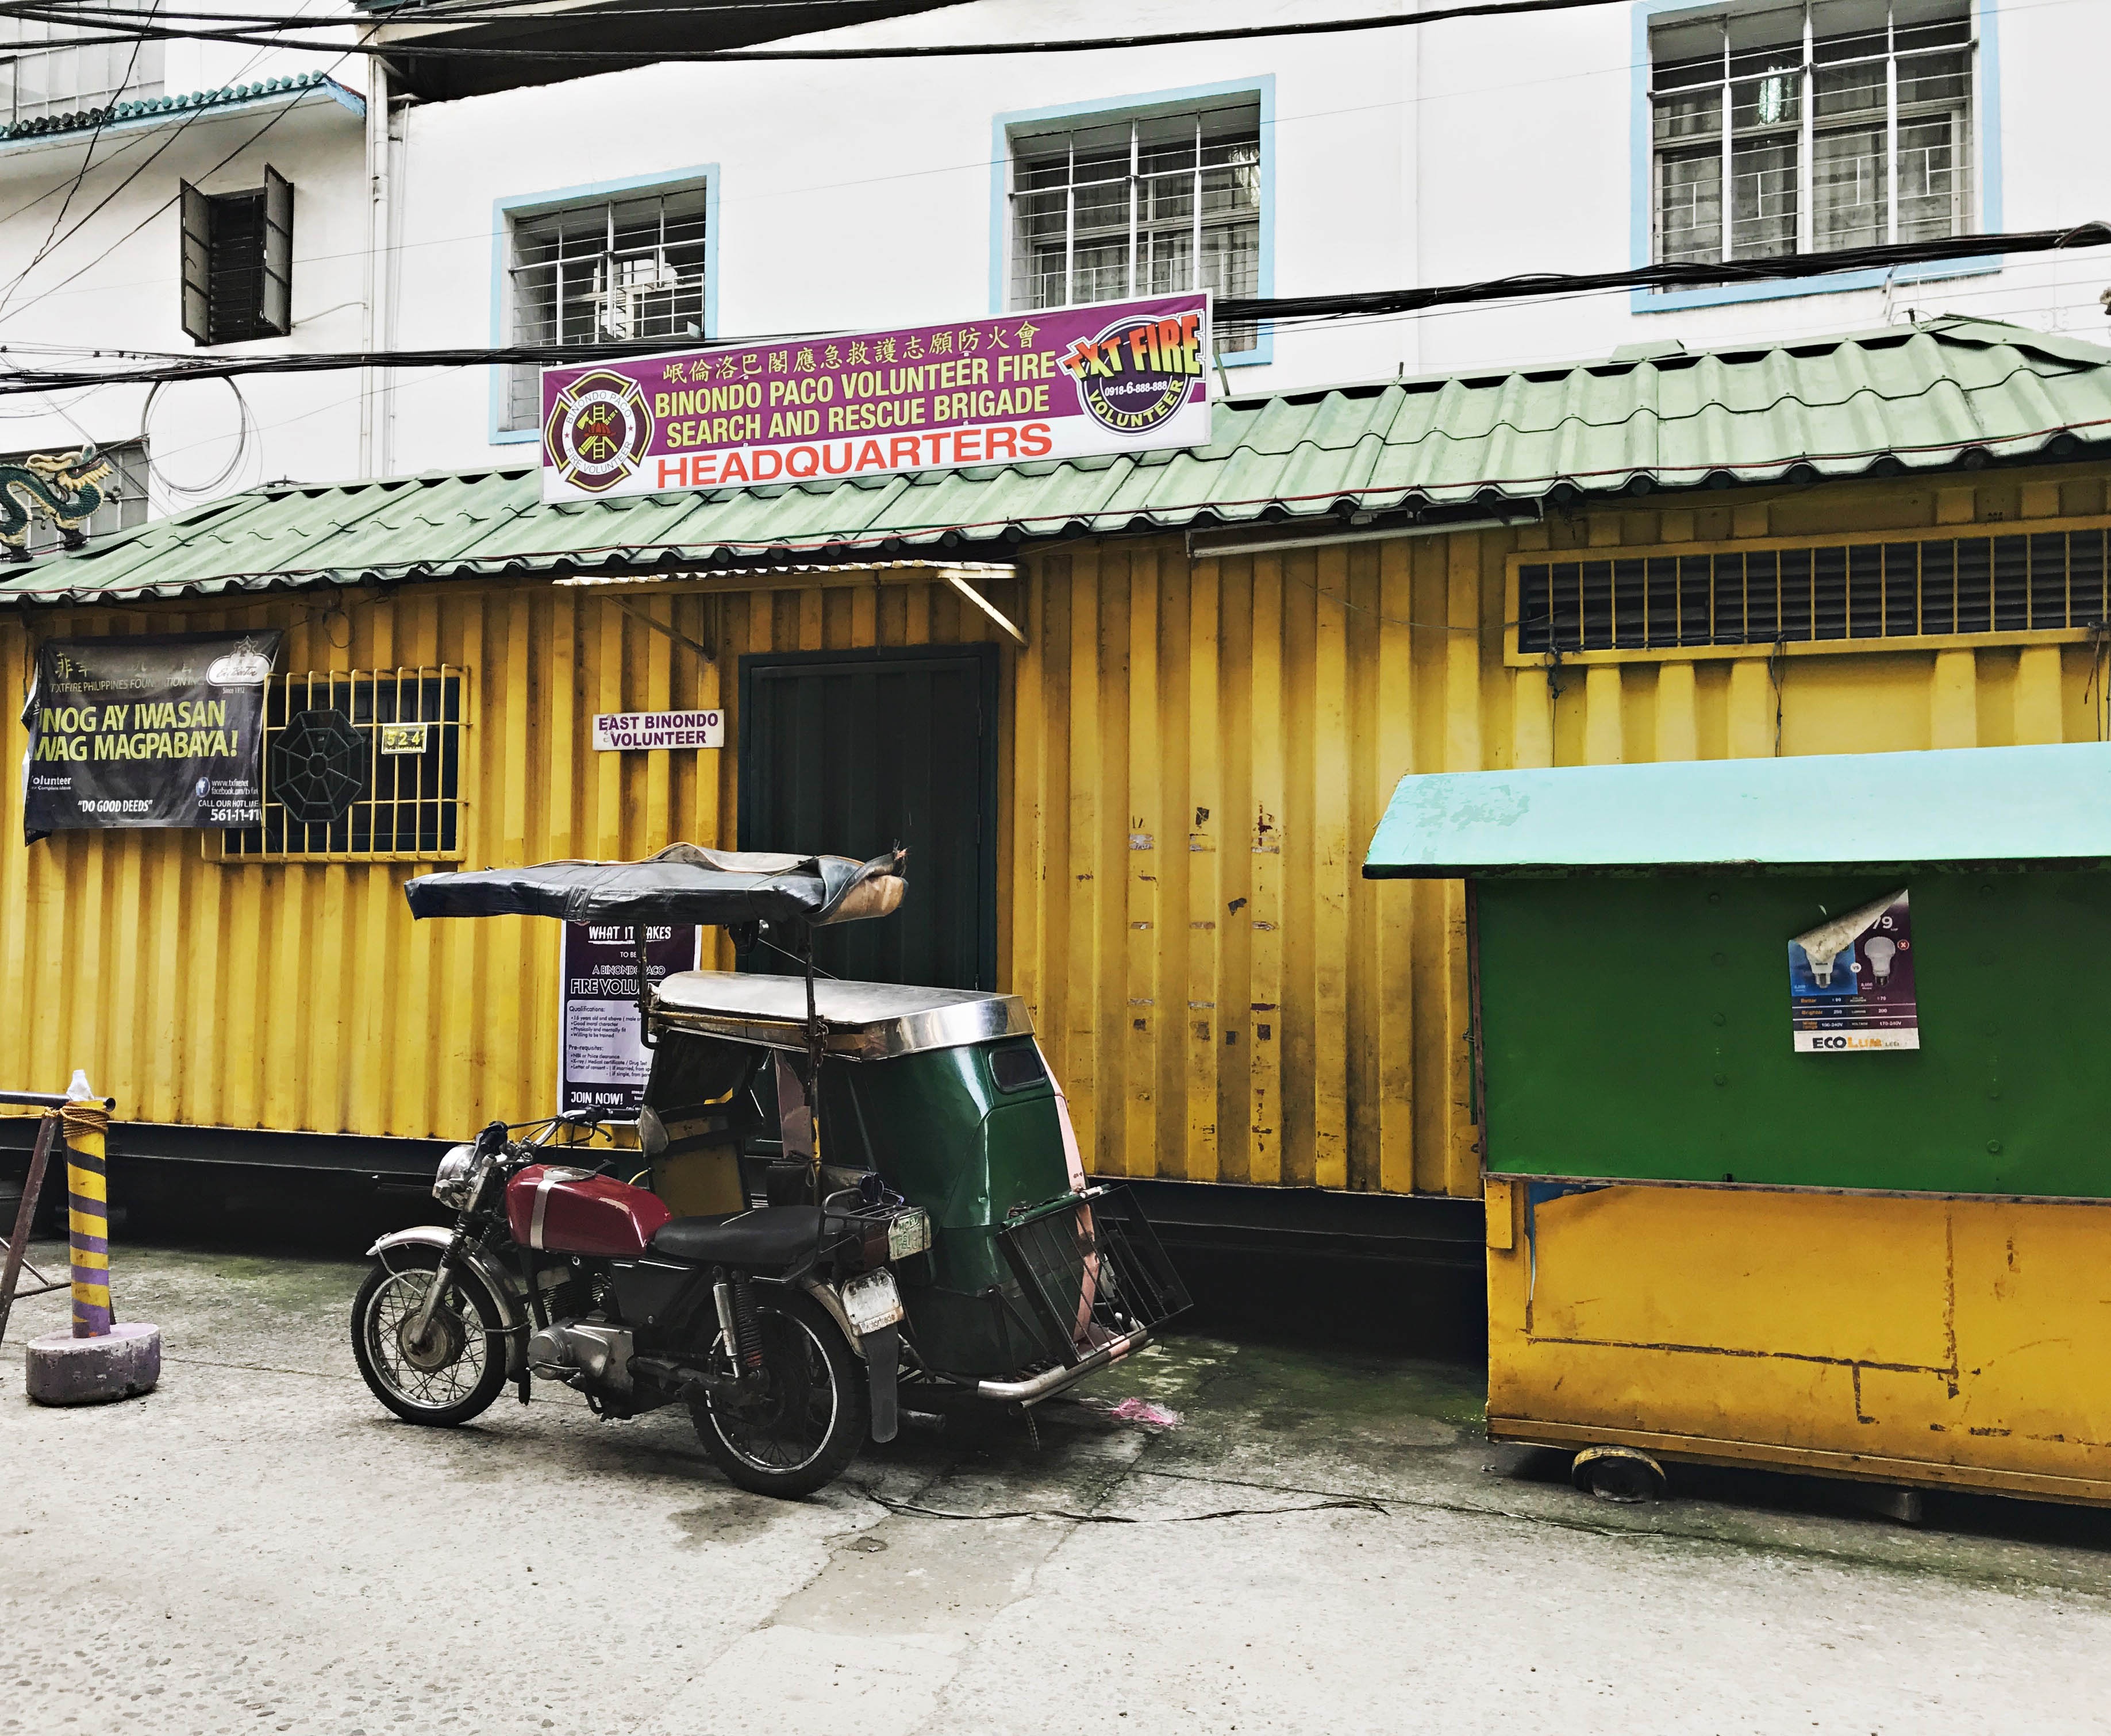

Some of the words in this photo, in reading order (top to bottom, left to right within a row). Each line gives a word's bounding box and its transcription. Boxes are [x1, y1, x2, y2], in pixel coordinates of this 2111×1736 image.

[1063, 336, 1123, 379] TXT
[1129, 314, 1200, 374] FIRE
[656, 382, 762, 418] BINONDO
[770, 375, 833, 406] PACO
[842, 359, 989, 401] VOLUNTEER
[998, 351, 1056, 384] FIRE
[1105, 381, 1168, 397] 0918-6-888-888
[566, 391, 606, 424] BINONDO
[609, 393, 632, 418] PACO
[1089, 379, 1184, 428] VOLUNTEER
[667, 414, 761, 448] SEARCH
[768, 407, 820, 439] AND
[828, 397, 925, 433] RESCUE
[934, 384, 1050, 422] BRIGADE
[566, 447, 583, 468] FIRE
[583, 441, 633, 474] VOLUNTEER
[657, 423, 1052, 489] HEADQUARTERS
[51, 682, 82, 693] TXTFIRE
[83, 679, 128, 691] PHILIPPINES
[101, 705, 129, 732] AY
[134, 700, 226, 730] IWASAN
[598, 716, 639, 730] EAST
[645, 713, 718, 729] BINONDO
[94, 730, 239, 761] MAGPABAYA!
[386, 731, 421, 746] 524
[610, 730, 707, 747] VOLUNTEER
[32, 775, 71, 785] olunteer
[97, 800, 122, 813] GOOD
[589, 926, 620, 940] WHAT
[625, 926, 635, 940] IT
[592, 964, 600, 975] A
[645, 965, 666, 976] ACO
[571, 979, 598, 994] FIRE
[571, 1091, 592, 1103] JOIN
[595, 1092, 623, 1105] NOW!
